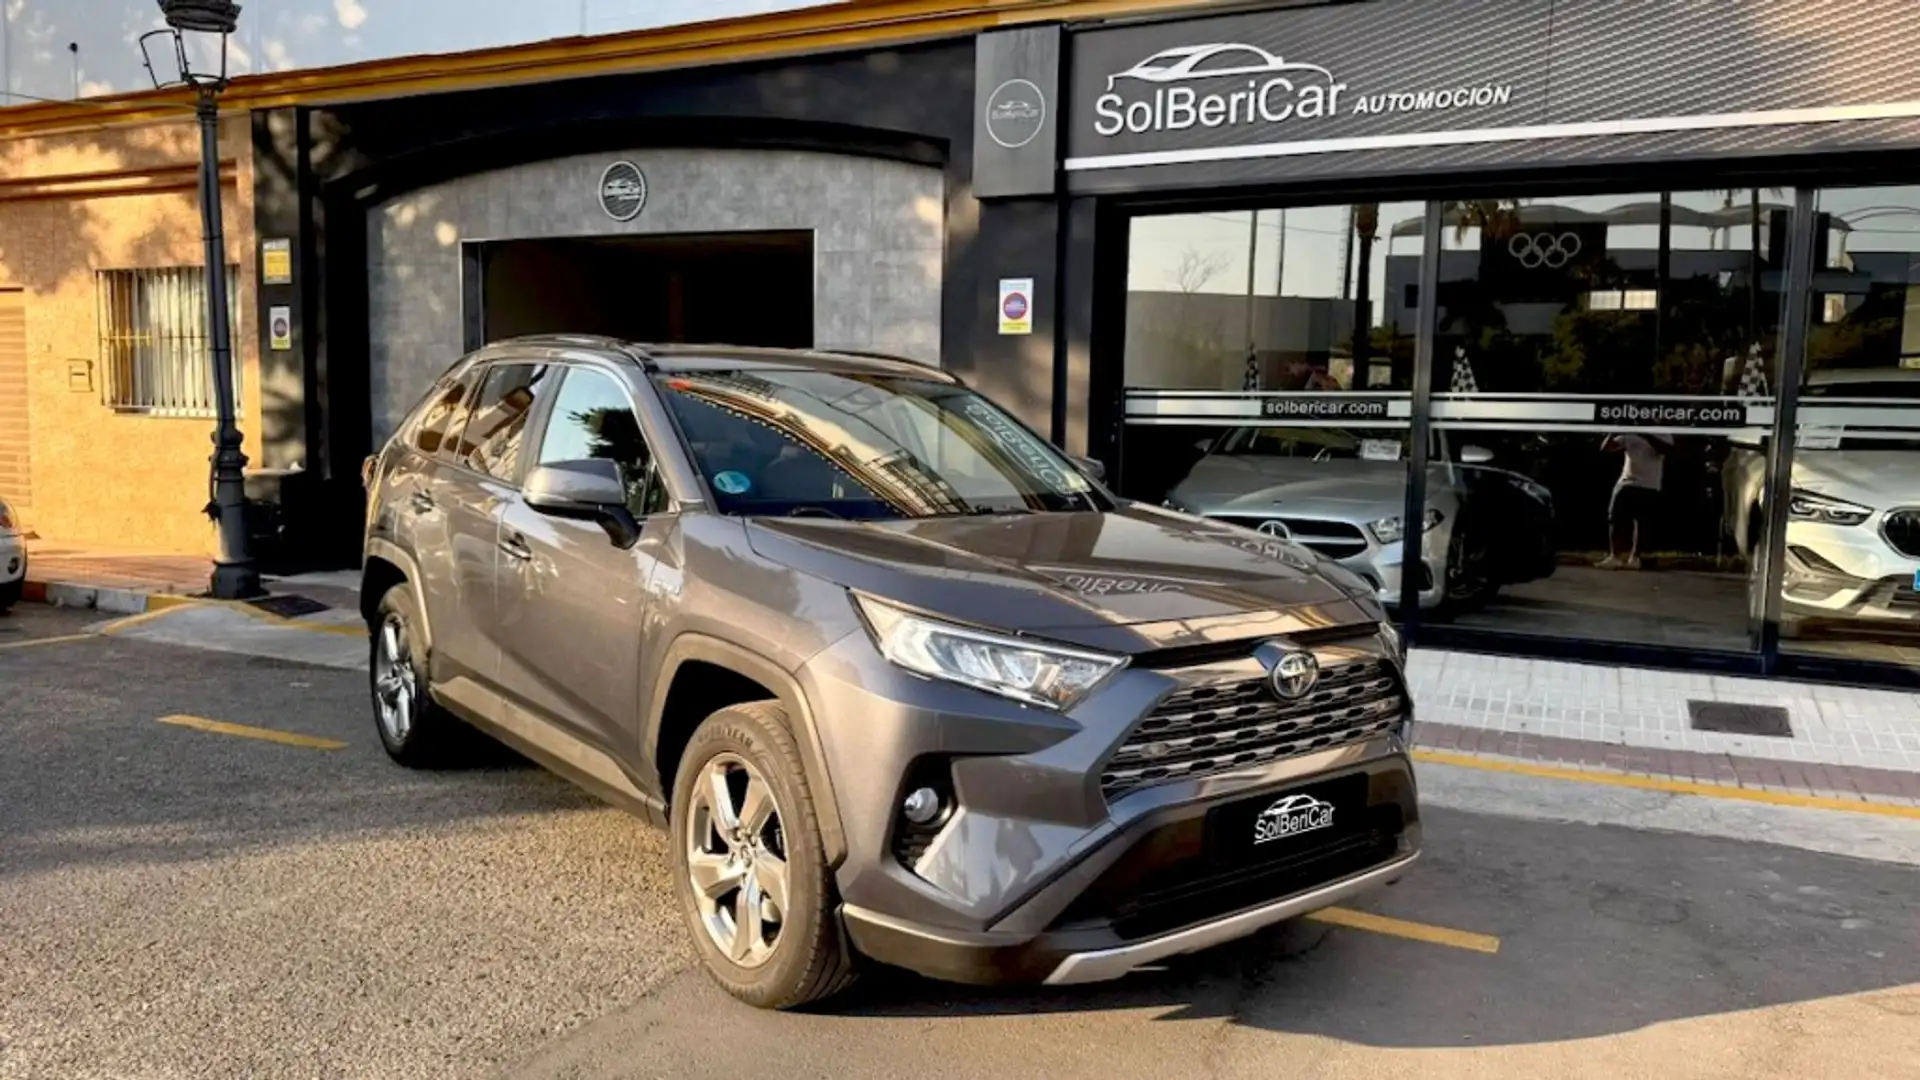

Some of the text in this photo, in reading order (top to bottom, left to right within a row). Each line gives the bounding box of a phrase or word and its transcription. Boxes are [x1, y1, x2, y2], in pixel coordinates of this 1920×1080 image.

[1094, 78, 1512, 136] SolBeriCar AUTOMOCIÓN
[1265, 400, 1384, 415] solbericar.com
[1600, 404, 1741, 421] solbericar.com
[1254, 805, 1336, 840] SolBeriCar
